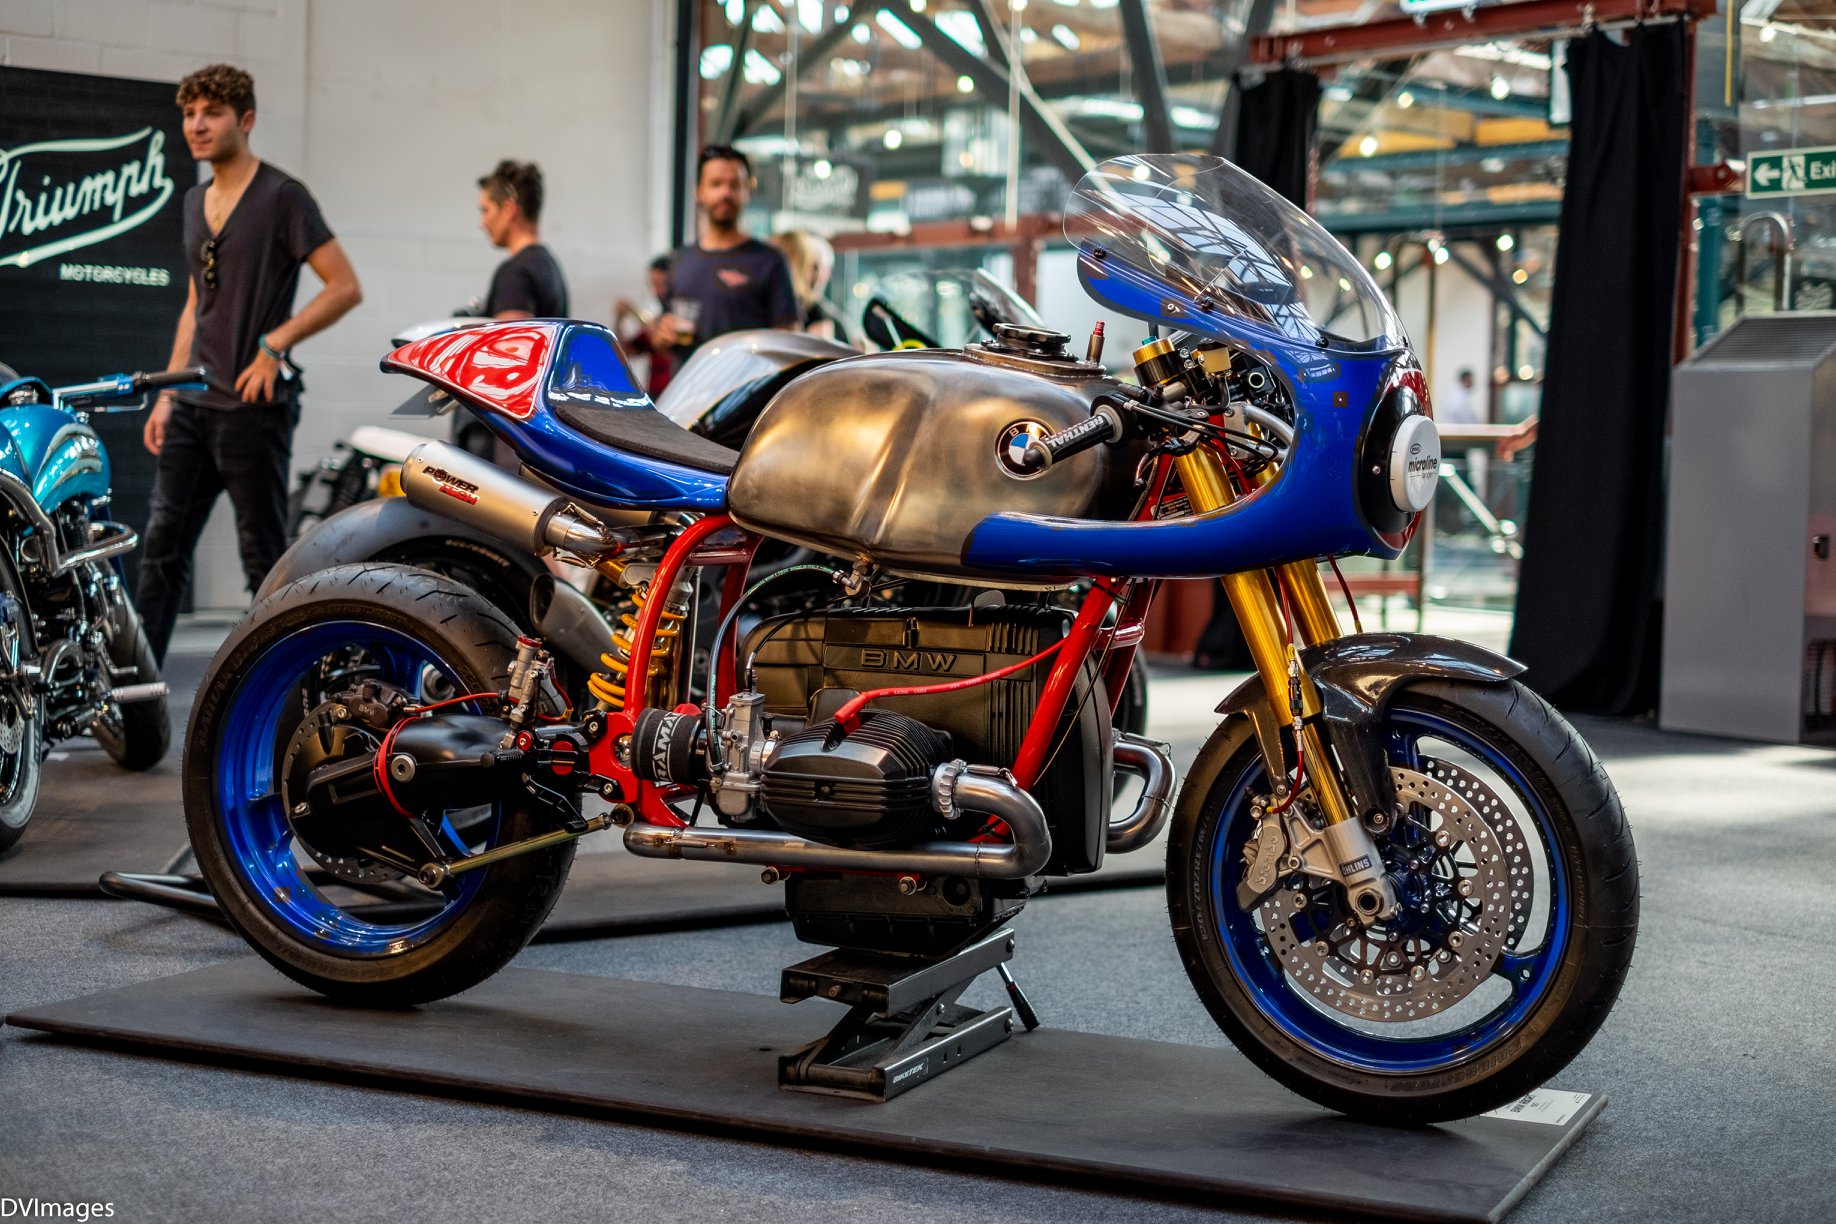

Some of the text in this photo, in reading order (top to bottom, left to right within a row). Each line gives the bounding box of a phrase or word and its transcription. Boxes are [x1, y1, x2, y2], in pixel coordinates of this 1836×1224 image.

[1810, 160, 1836, 180] Exi
[0, 127, 174, 240] Triumph
[60, 263, 170, 286] MOTORCYCLES
[1047, 415, 1105, 448] RENTHAL
[861, 649, 958, 673] BMW
